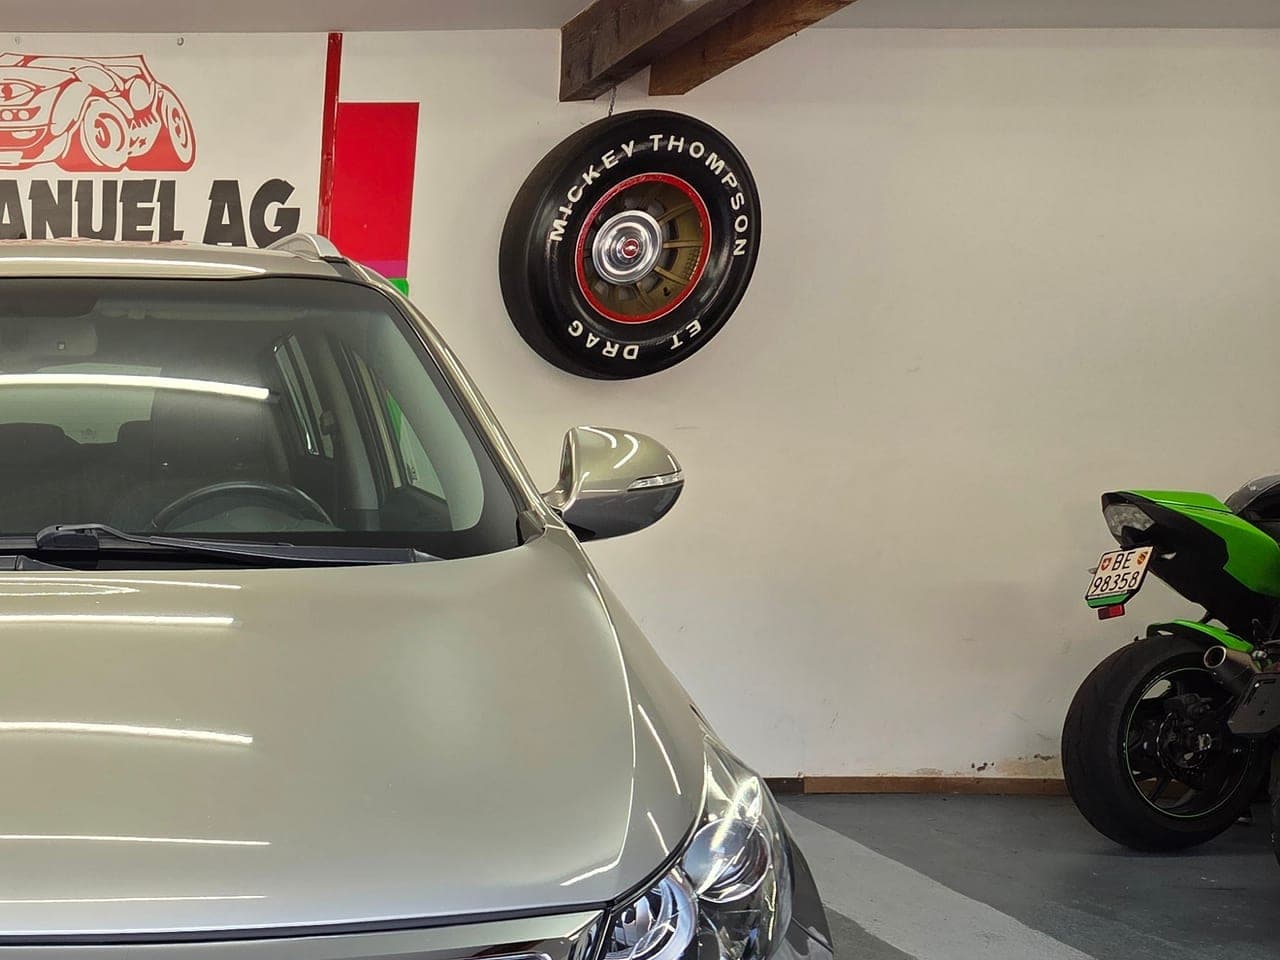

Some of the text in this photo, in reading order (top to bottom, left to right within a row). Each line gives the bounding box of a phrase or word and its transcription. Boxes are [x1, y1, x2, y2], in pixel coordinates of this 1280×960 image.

[202, 178, 302, 249] AG
[548, 133, 749, 257] MICKEY THOMPSON
[567, 319, 703, 361] ET DRAG
[1111, 551, 1137, 571] BE
[1090, 571, 1140, 595] 98358
